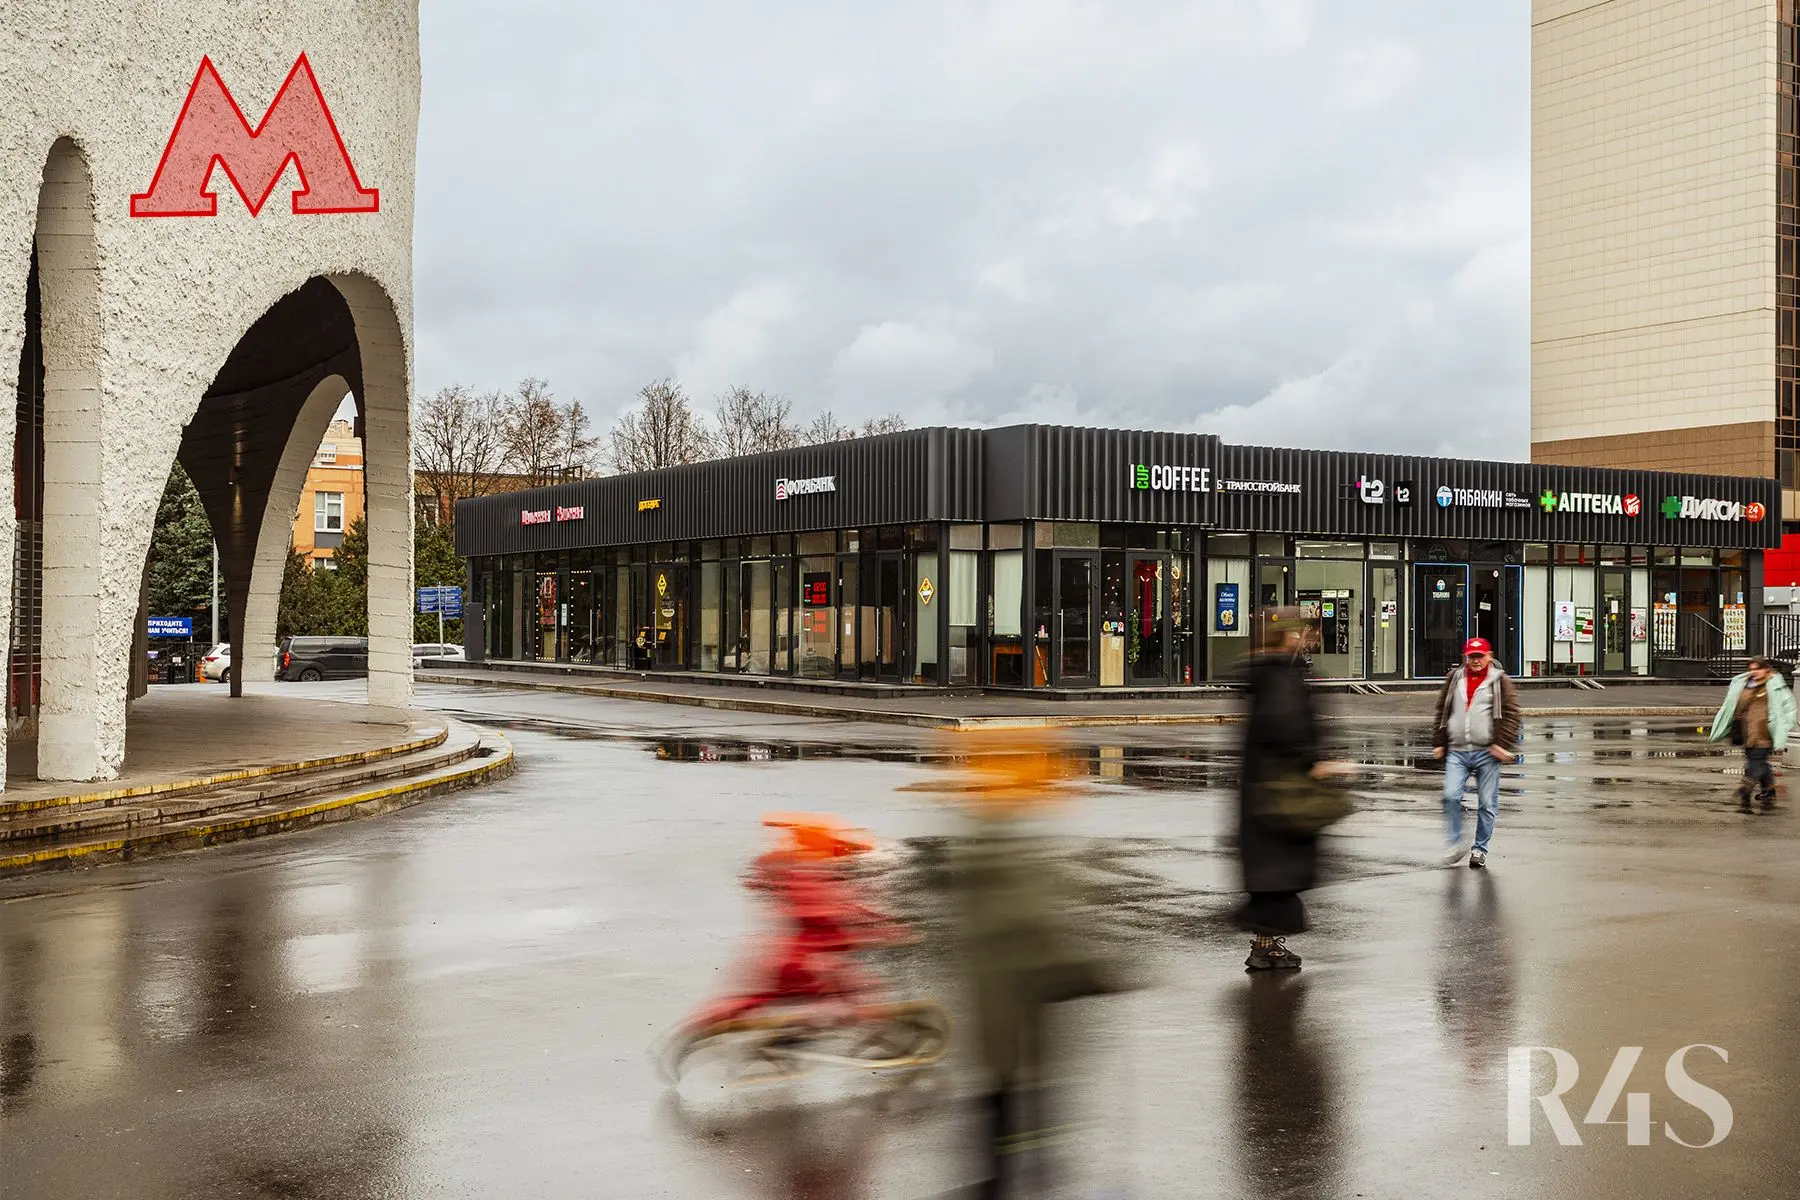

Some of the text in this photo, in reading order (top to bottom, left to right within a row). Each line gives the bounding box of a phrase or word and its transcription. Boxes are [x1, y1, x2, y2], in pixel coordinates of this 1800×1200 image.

[787, 476, 836, 495] ФОРАБАНК
[1137, 464, 1149, 489] CUP
[1151, 465, 1210, 492] COFFEE
[1226, 480, 1301, 493] ТРАНССТРОЙБАНК
[1454, 488, 1502, 508] ТАБАКИН
[1558, 492, 1623, 515] АПТЕКА
[1680, 495, 1740, 521] ДИКСИ
[1748, 505, 1758, 513] 24
